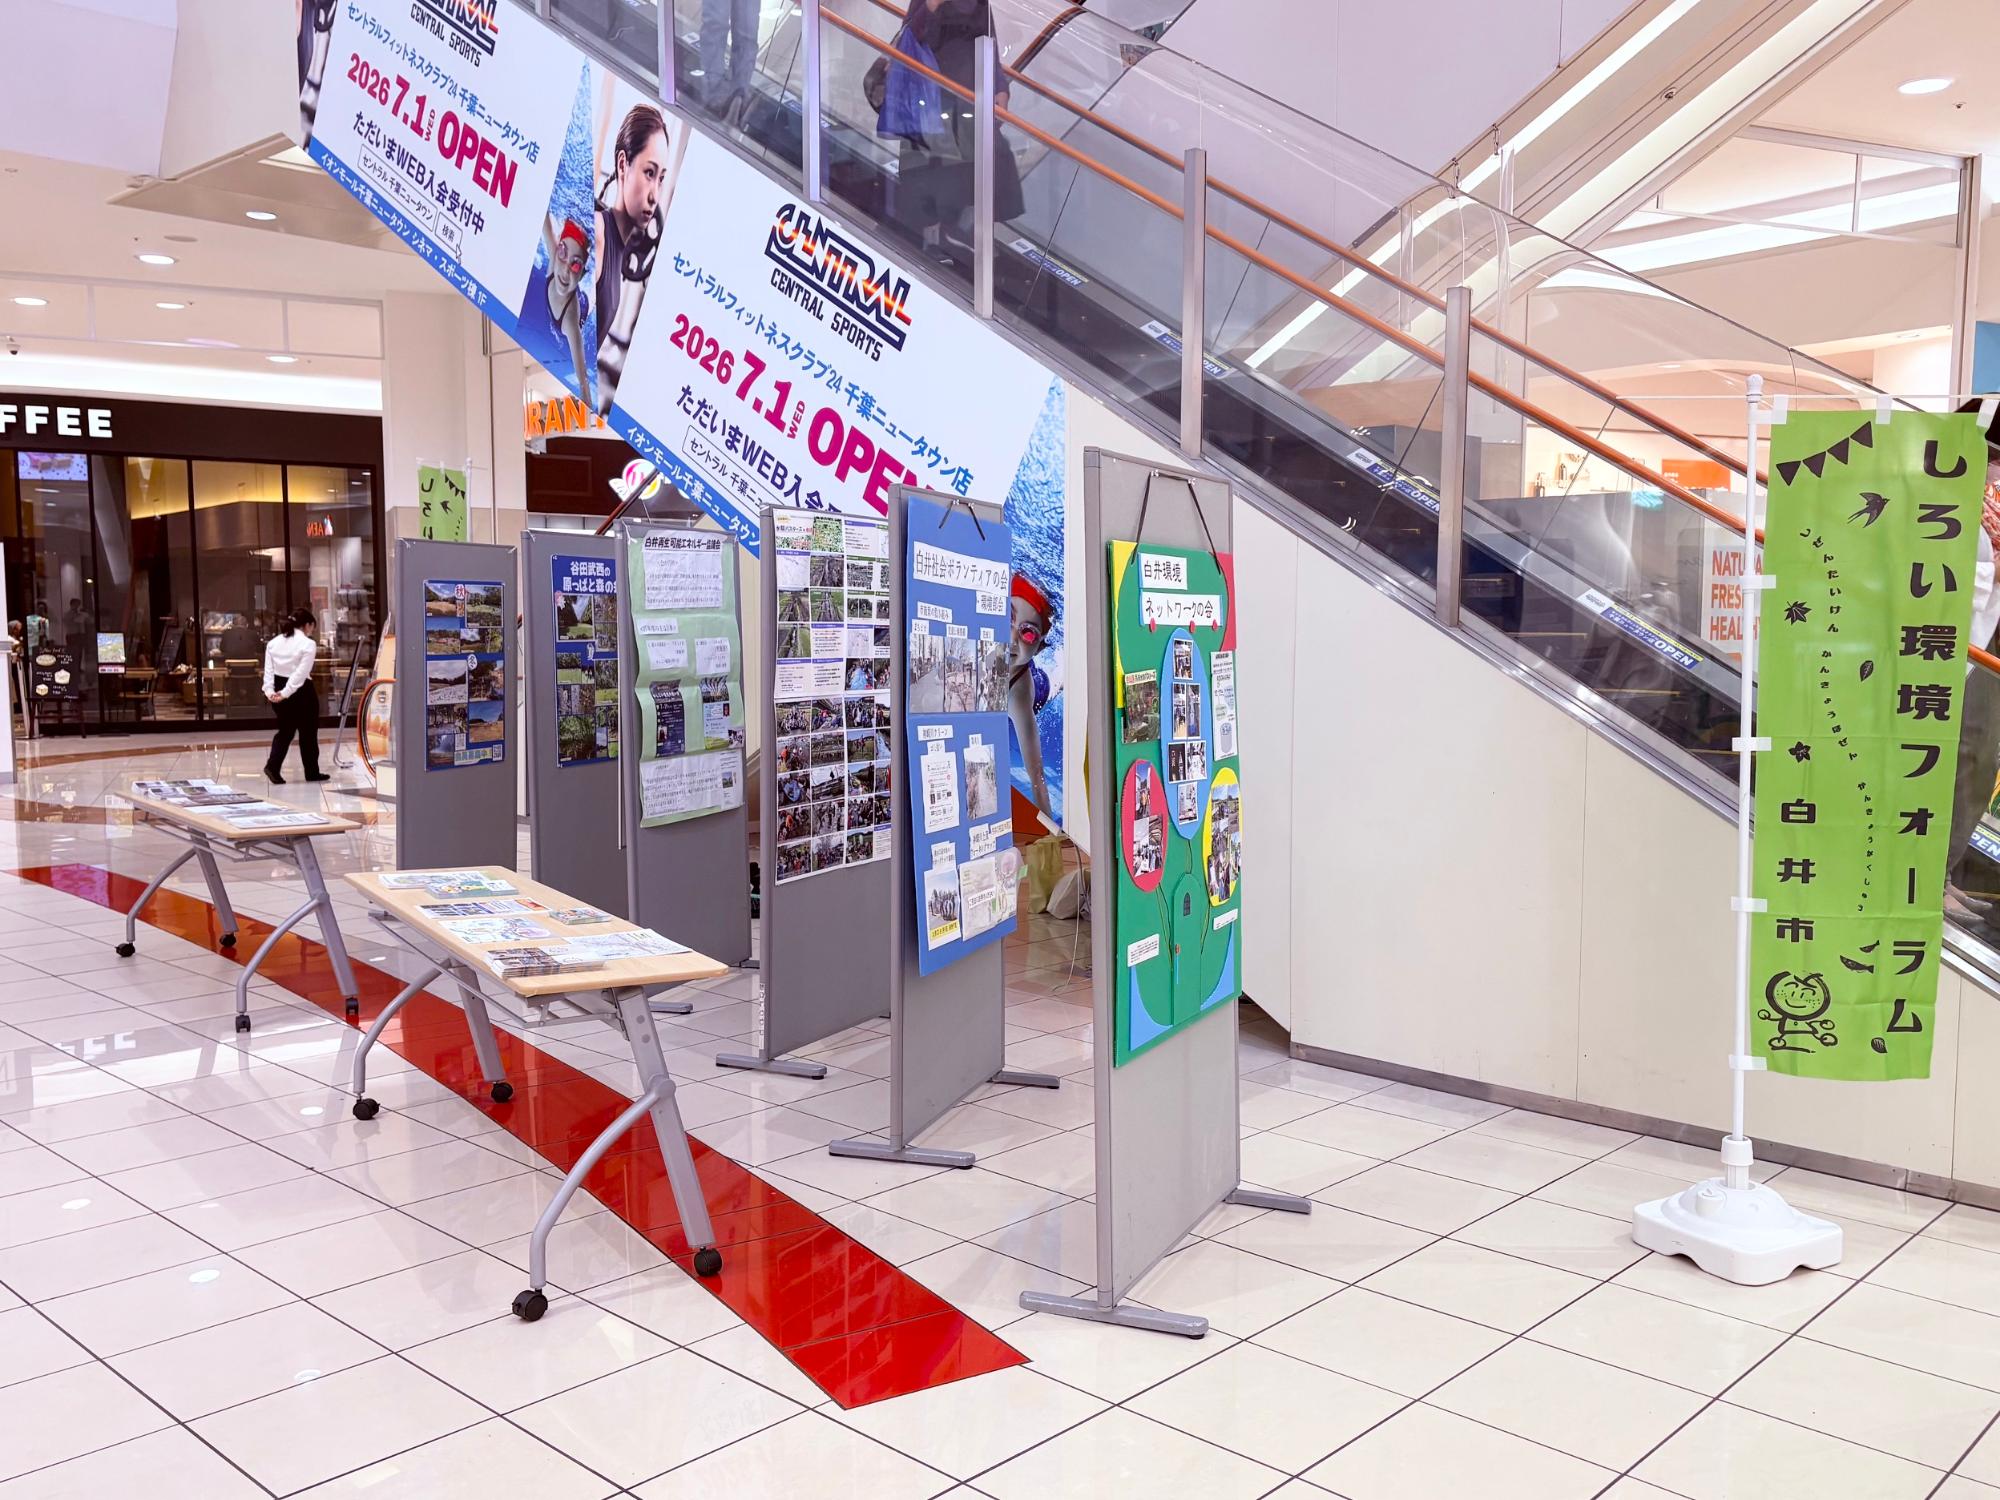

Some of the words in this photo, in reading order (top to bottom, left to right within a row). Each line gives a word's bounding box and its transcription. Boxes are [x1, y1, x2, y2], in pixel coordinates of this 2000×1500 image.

[410, 3, 445, 42] CENTRAL
[449, 32, 482, 68] SPORTS
[346, 52, 391, 107] 2026
[391, 74, 428, 141] 7.1
[424, 109, 436, 142] WED
[437, 110, 519, 208] OPEN
[352, 110, 486, 235] ただいまWEB入会受付中
[320, 153, 411, 237] イオンモール千葉ニュータウン
[477, 289, 488, 306] 1F
[764, 203, 913, 328] CENTRAL
[770, 267, 824, 321] CENTRAL
[830, 311, 885, 362] SPORTS
[1203, 359, 1222, 375] PEN
[0, 404, 112, 438] FFEE
[524, 395, 604, 440] RAN
[669, 313, 735, 385] 2026
[735, 349, 793, 435] 7.1
[787, 401, 806, 440] WED
[808, 407, 935, 517] OPE
[844, 381, 975, 497] 千葉ニュータウン店
[690, 437, 727, 477] セントラル
[421, 478, 434, 540] しろい
[1144, 560, 1182, 583] 白井環境
[1711, 583, 1744, 609] FRES
[1145, 597, 1214, 619] ネットワークの会
[1654, 639, 1694, 666] OPEN
[1887, 440, 1967, 1033] しろい環境フォーラム
[1776, 798, 1817, 942] 白井市
